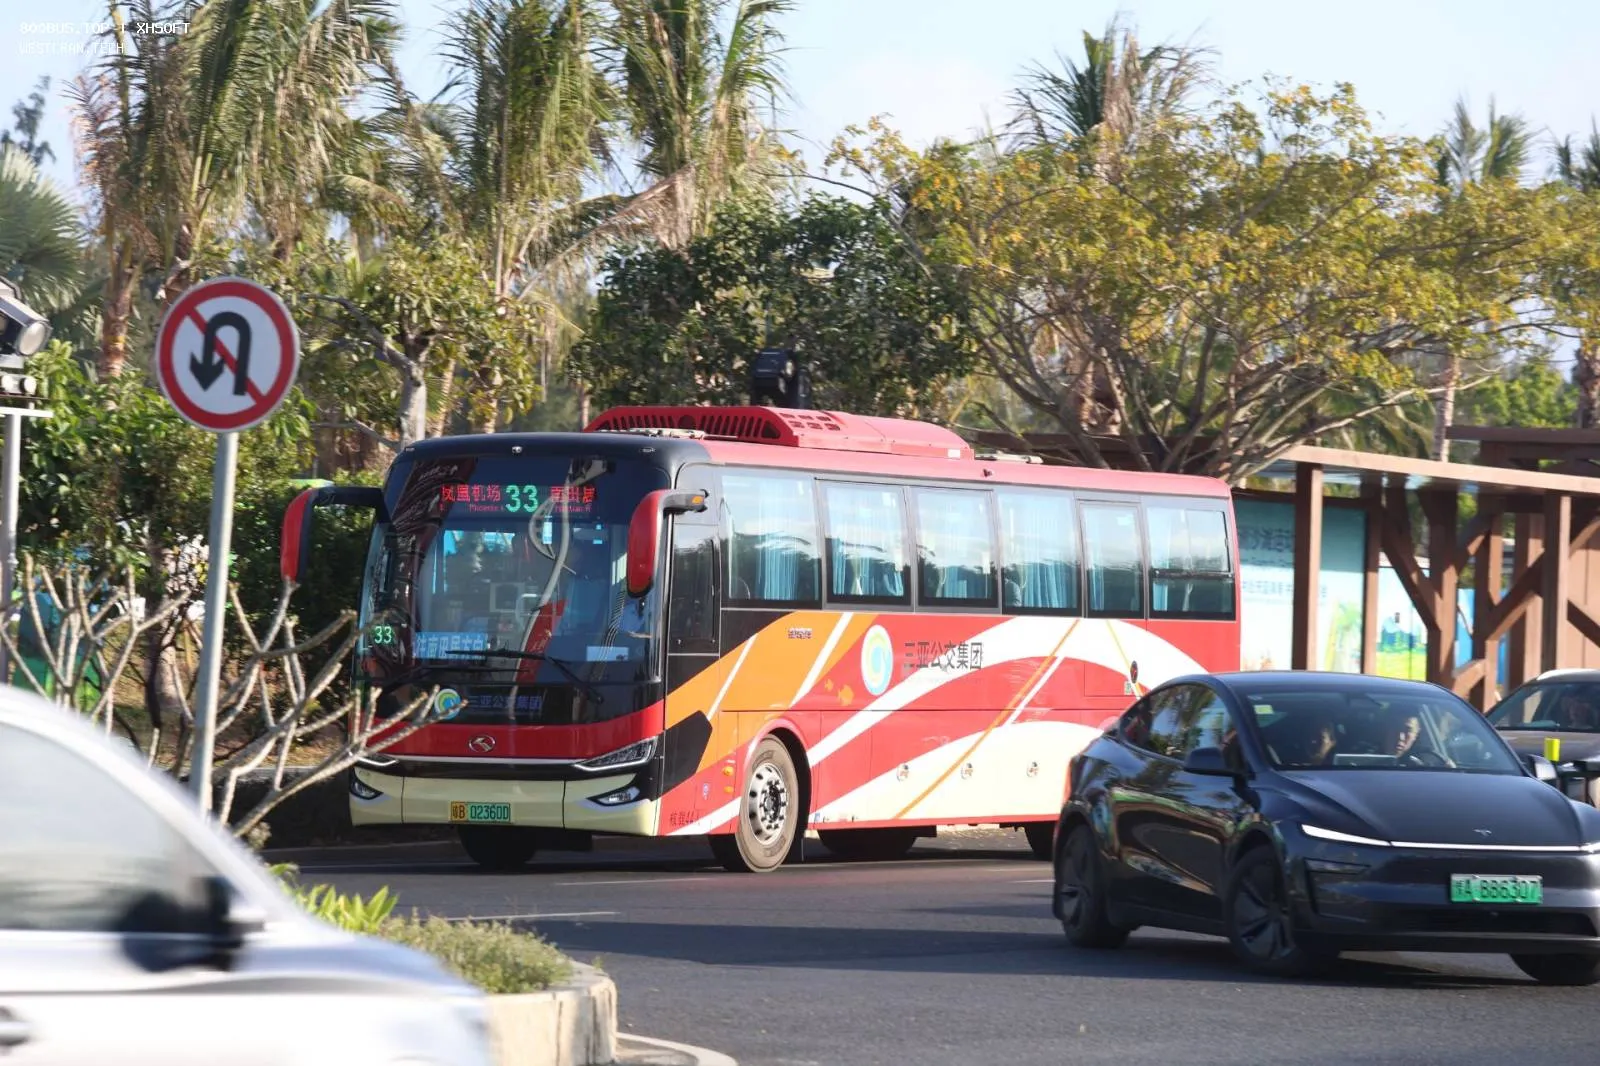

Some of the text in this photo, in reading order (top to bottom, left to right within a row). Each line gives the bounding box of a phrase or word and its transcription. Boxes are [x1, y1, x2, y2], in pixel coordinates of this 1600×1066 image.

[441, 484, 501, 502] 凤凰机场
[505, 484, 539, 513] 33
[374, 625, 393, 645] 33
[904, 641, 983, 670] 三亚公交集团
